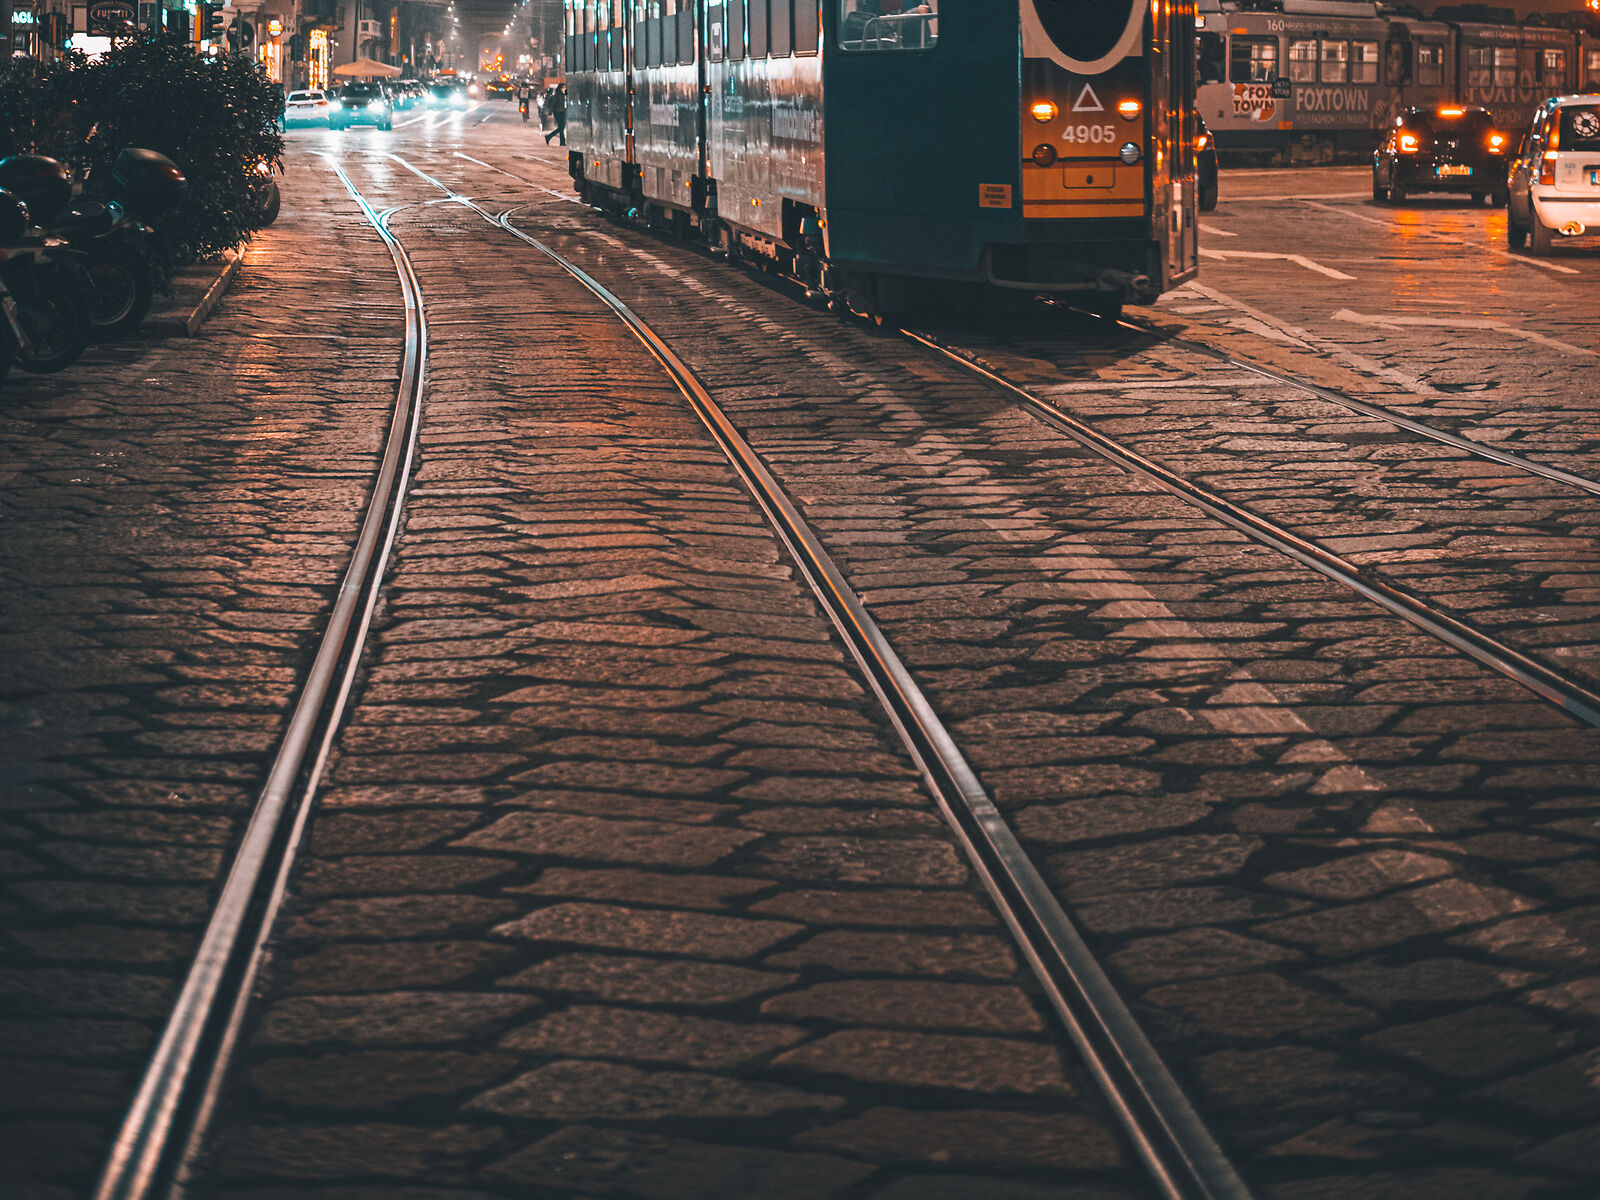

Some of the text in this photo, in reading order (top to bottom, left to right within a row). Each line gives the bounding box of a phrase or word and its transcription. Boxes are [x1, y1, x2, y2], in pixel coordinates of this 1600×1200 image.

[1267, 19, 1285, 31] 160
[1248, 86, 1273, 99] FOX
[1296, 88, 1368, 111] FOXTOWN
[1233, 100, 1275, 113] TOWN
[1061, 125, 1116, 143] 4905
